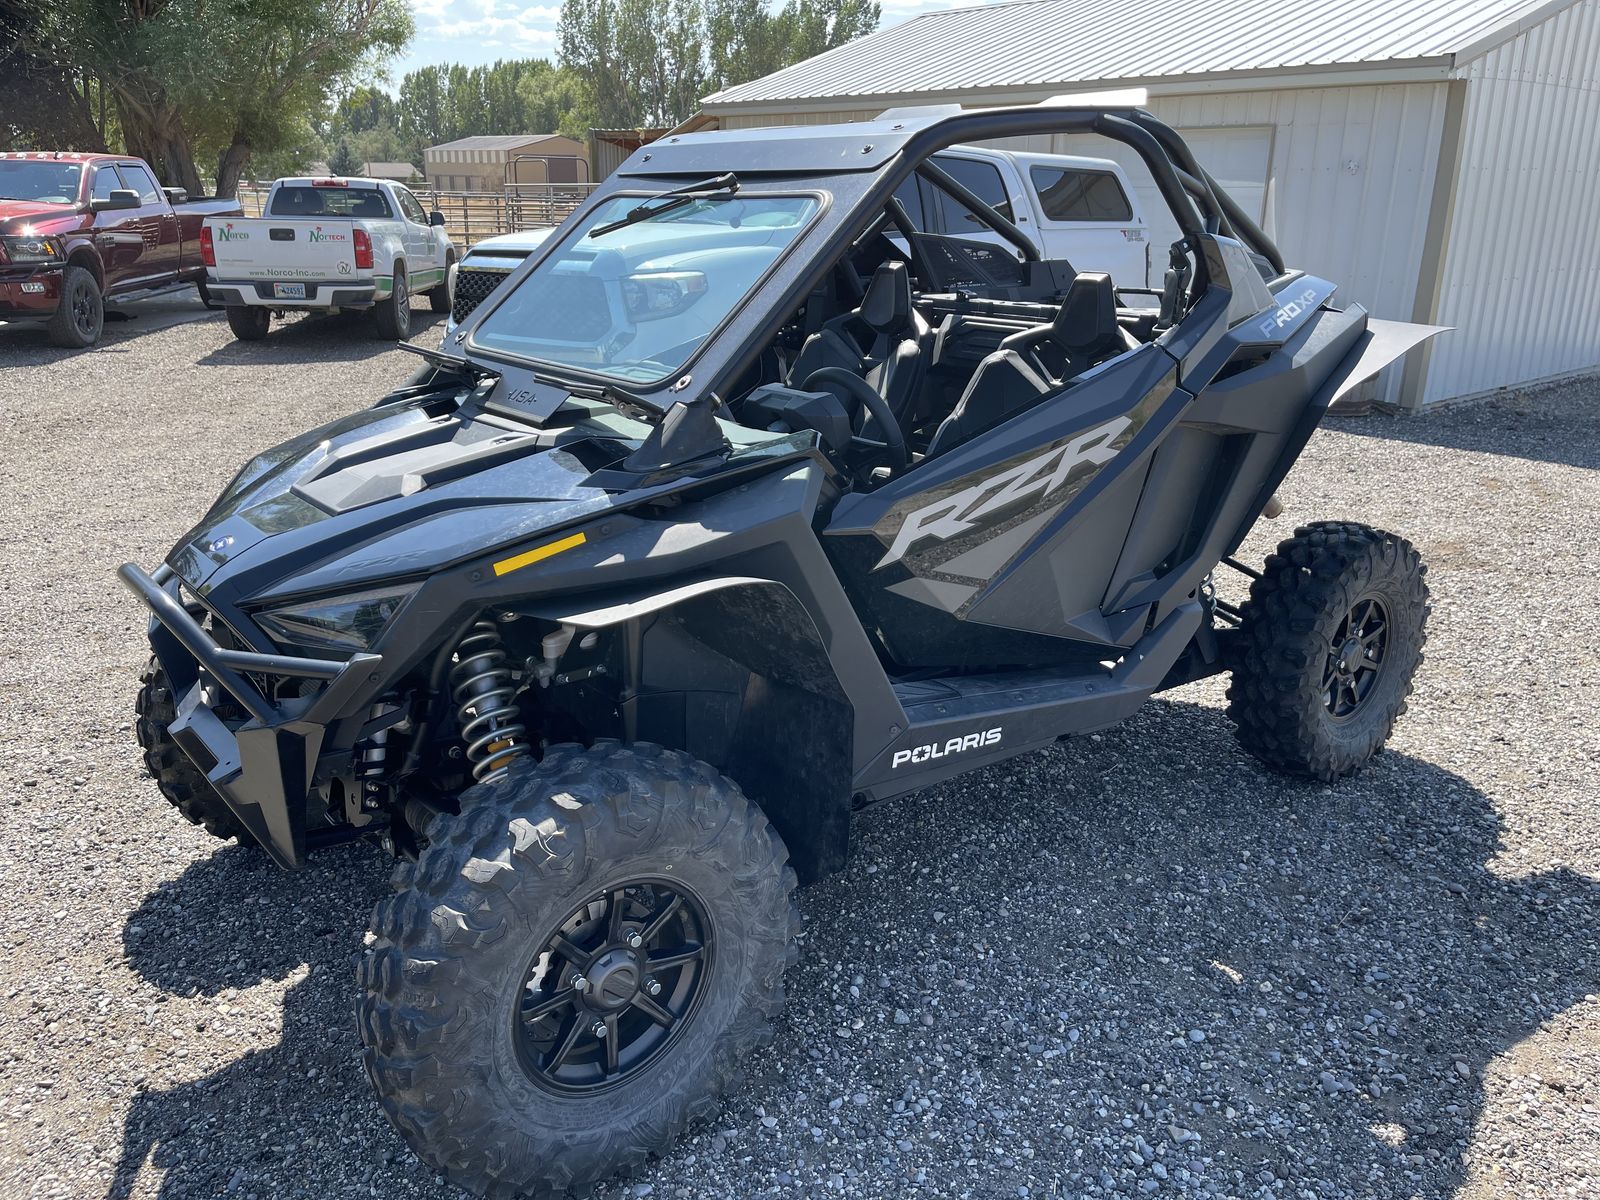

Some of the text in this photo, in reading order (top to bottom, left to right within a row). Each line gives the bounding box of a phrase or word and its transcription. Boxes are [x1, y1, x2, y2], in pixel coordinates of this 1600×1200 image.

[218, 225, 249, 241] Norco
[248, 269, 326, 277] www.Norco-Inc.com
[872, 416, 1132, 571] RZR
[891, 727, 1003, 769] POLARIS
